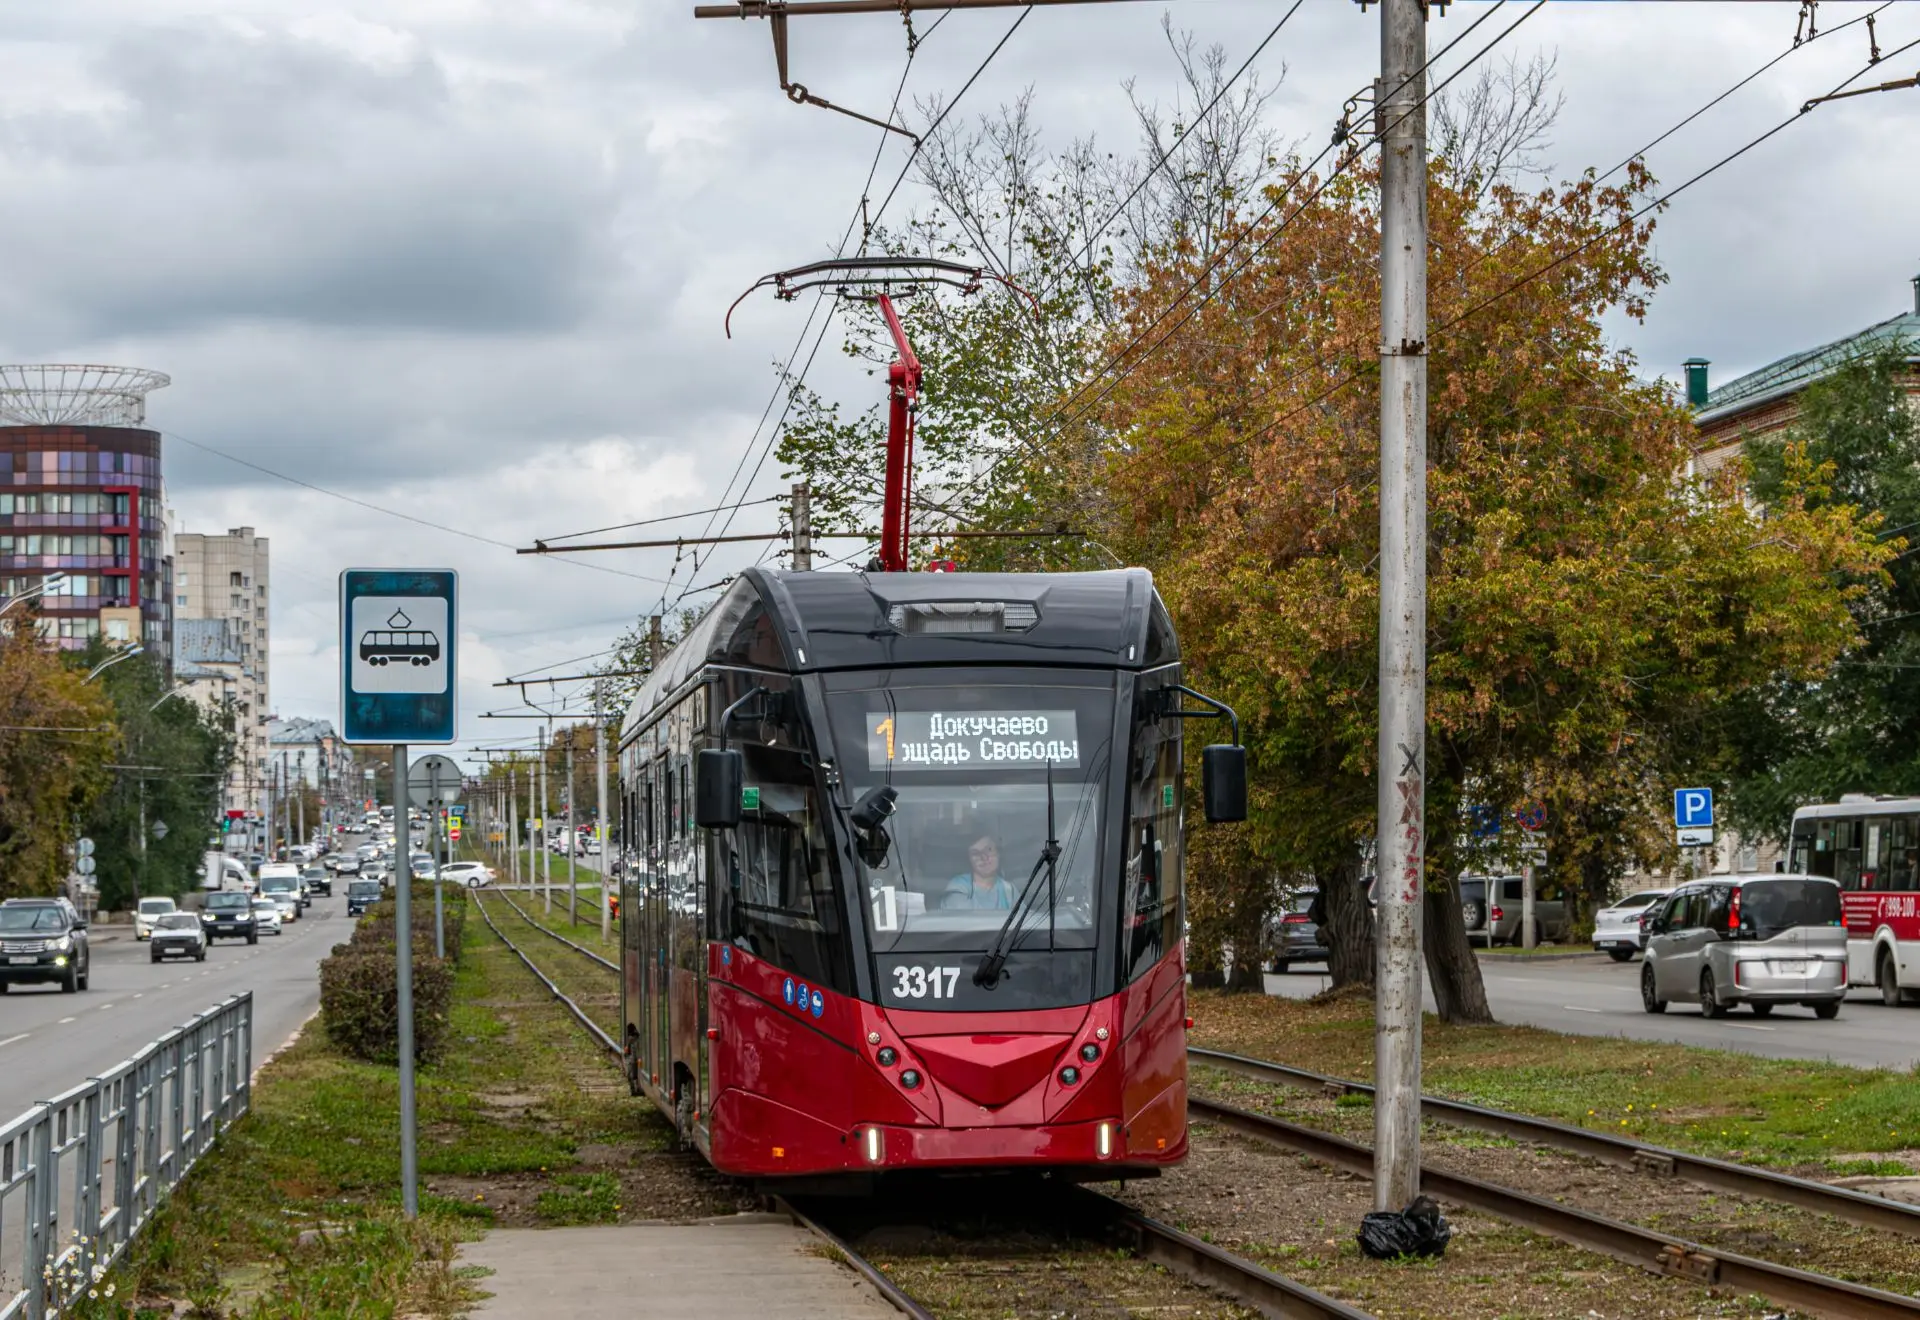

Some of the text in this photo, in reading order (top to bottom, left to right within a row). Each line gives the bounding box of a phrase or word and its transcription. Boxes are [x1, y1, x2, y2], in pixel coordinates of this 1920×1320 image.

[876, 717, 895, 760] 1
[930, 713, 1048, 740] Докучаево
[980, 738, 1078, 763] Свободы
[1685, 792, 1706, 822] P
[892, 965, 961, 998] 3317
